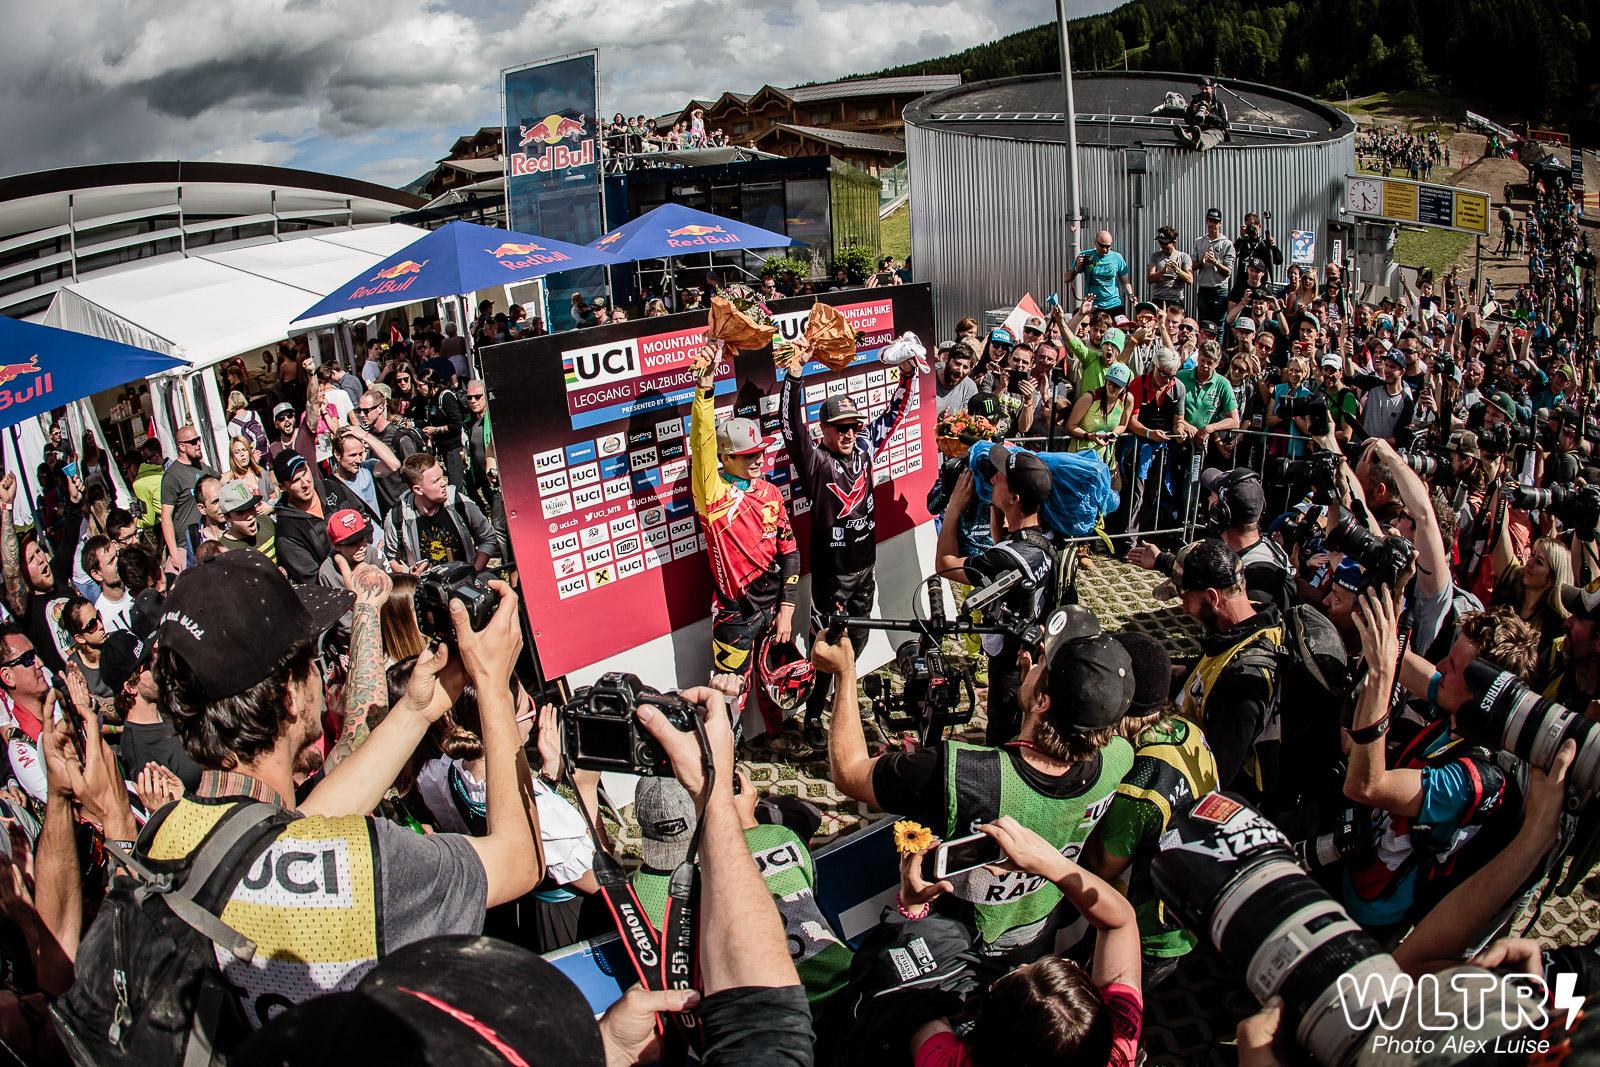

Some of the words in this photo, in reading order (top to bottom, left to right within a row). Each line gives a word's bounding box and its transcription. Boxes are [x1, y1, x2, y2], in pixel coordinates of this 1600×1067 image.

[511, 145, 553, 177] Red
[554, 139, 595, 170] Bull
[666, 235, 704, 248] Red
[704, 233, 741, 245] Bull
[498, 255, 531, 271] Red
[530, 250, 572, 267] Bull
[348, 282, 383, 301] Red
[382, 276, 419, 294] Bull
[840, 306, 873, 319] OUNTAIN
[874, 304, 891, 315] BIKE
[643, 333, 703, 354] MOUNTAIN
[577, 346, 635, 380] UCI
[644, 351, 685, 368] WORLD
[871, 374, 884, 382] UCI
[574, 385, 631, 408] LEOGANG
[639, 364, 731, 394] SALZBURGEAND
[831, 383, 845, 392] UCI
[621, 400, 655, 414] PRESENTED
[656, 398, 664, 406] BY
[737, 405, 757, 413] GoPro
[629, 431, 652, 440] GoPro
[662, 423, 681, 435] UCI
[892, 432, 904, 442] UCI
[910, 443, 921, 452] UCI
[541, 453, 562, 467] UCI
[775, 454, 789, 463] uci.ch
[876, 455, 888, 464] UCI
[577, 469, 597, 481] UCI
[894, 465, 906, 473] UCI
[545, 476, 566, 490] UCI
[611, 482, 630, 495] UCI
[580, 491, 601, 503] UCI
[635, 497, 647, 507] UCI
[648, 486, 688, 502] Mountainbike
[593, 505, 622, 519] UCI_MTB
[559, 518, 579, 530] uci.ch
[616, 519, 636, 532] UCI
[648, 530, 667, 543] UCI
[556, 537, 577, 551] UCI
[678, 542, 696, 553] UCI
[591, 550, 610, 562] UCI
[624, 560, 642, 572] UCI
[565, 579, 585, 592] UCI
[242, 848, 339, 895] UCI
[619, 903, 658, 967] Canon
[678, 916, 691, 947] Mark
[671, 951, 689, 975] 5D
